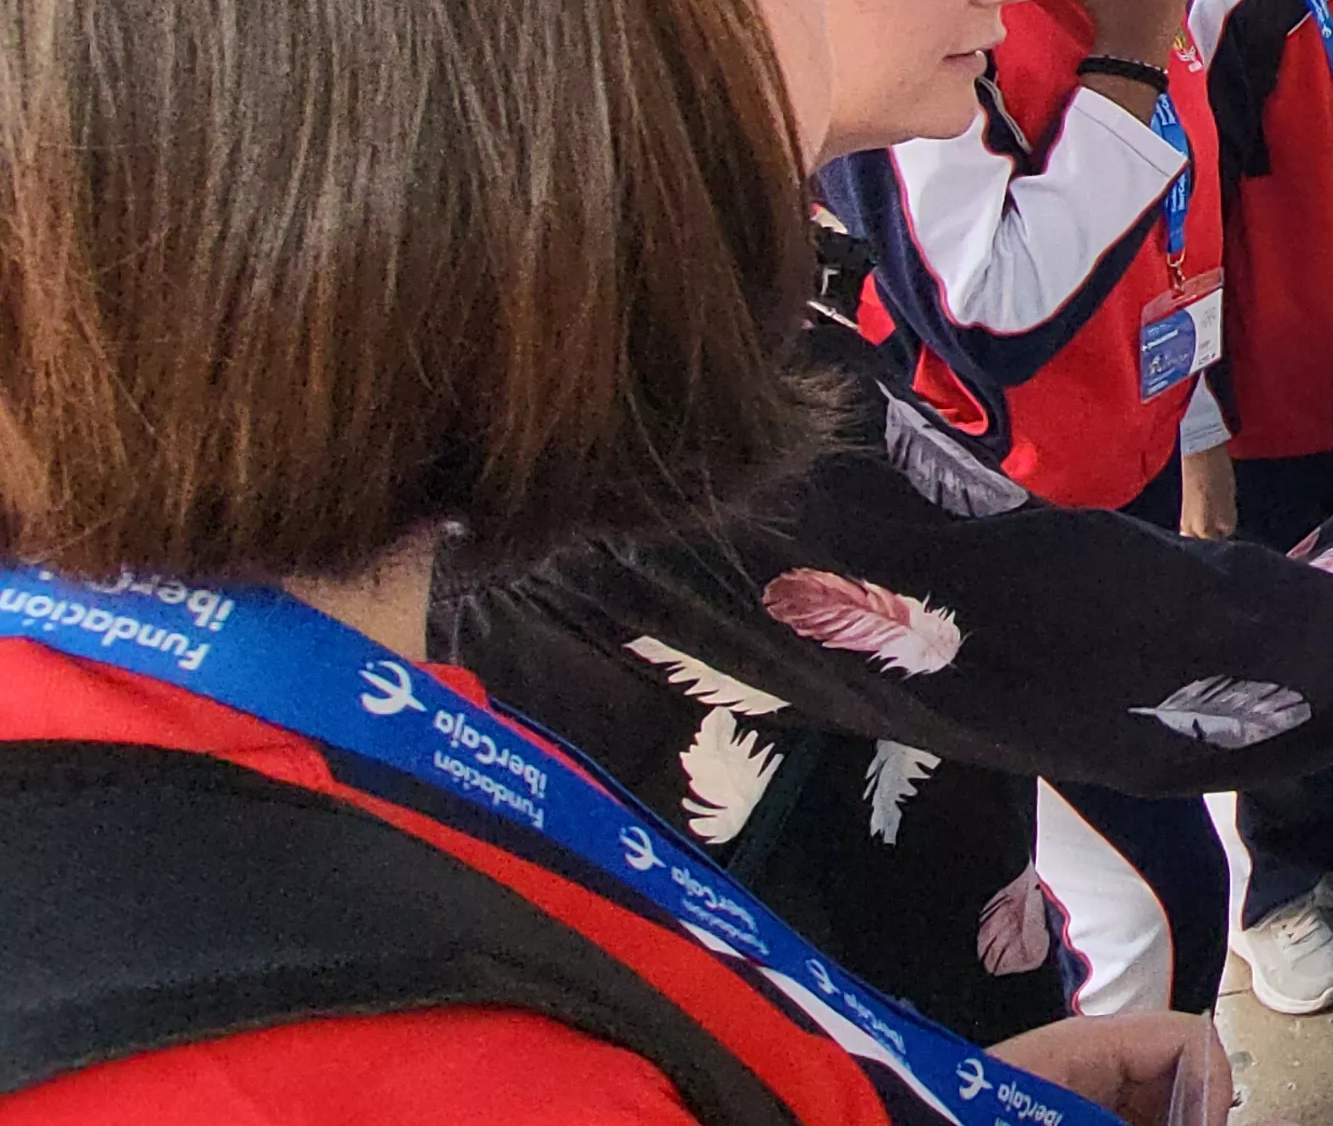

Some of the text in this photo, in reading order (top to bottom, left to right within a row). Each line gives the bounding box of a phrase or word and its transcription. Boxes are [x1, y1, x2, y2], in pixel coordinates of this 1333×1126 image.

[0, 587, 212, 671] Fundación
[433, 709, 547, 798] iberCaja
[433, 749, 545, 830] Fundación
